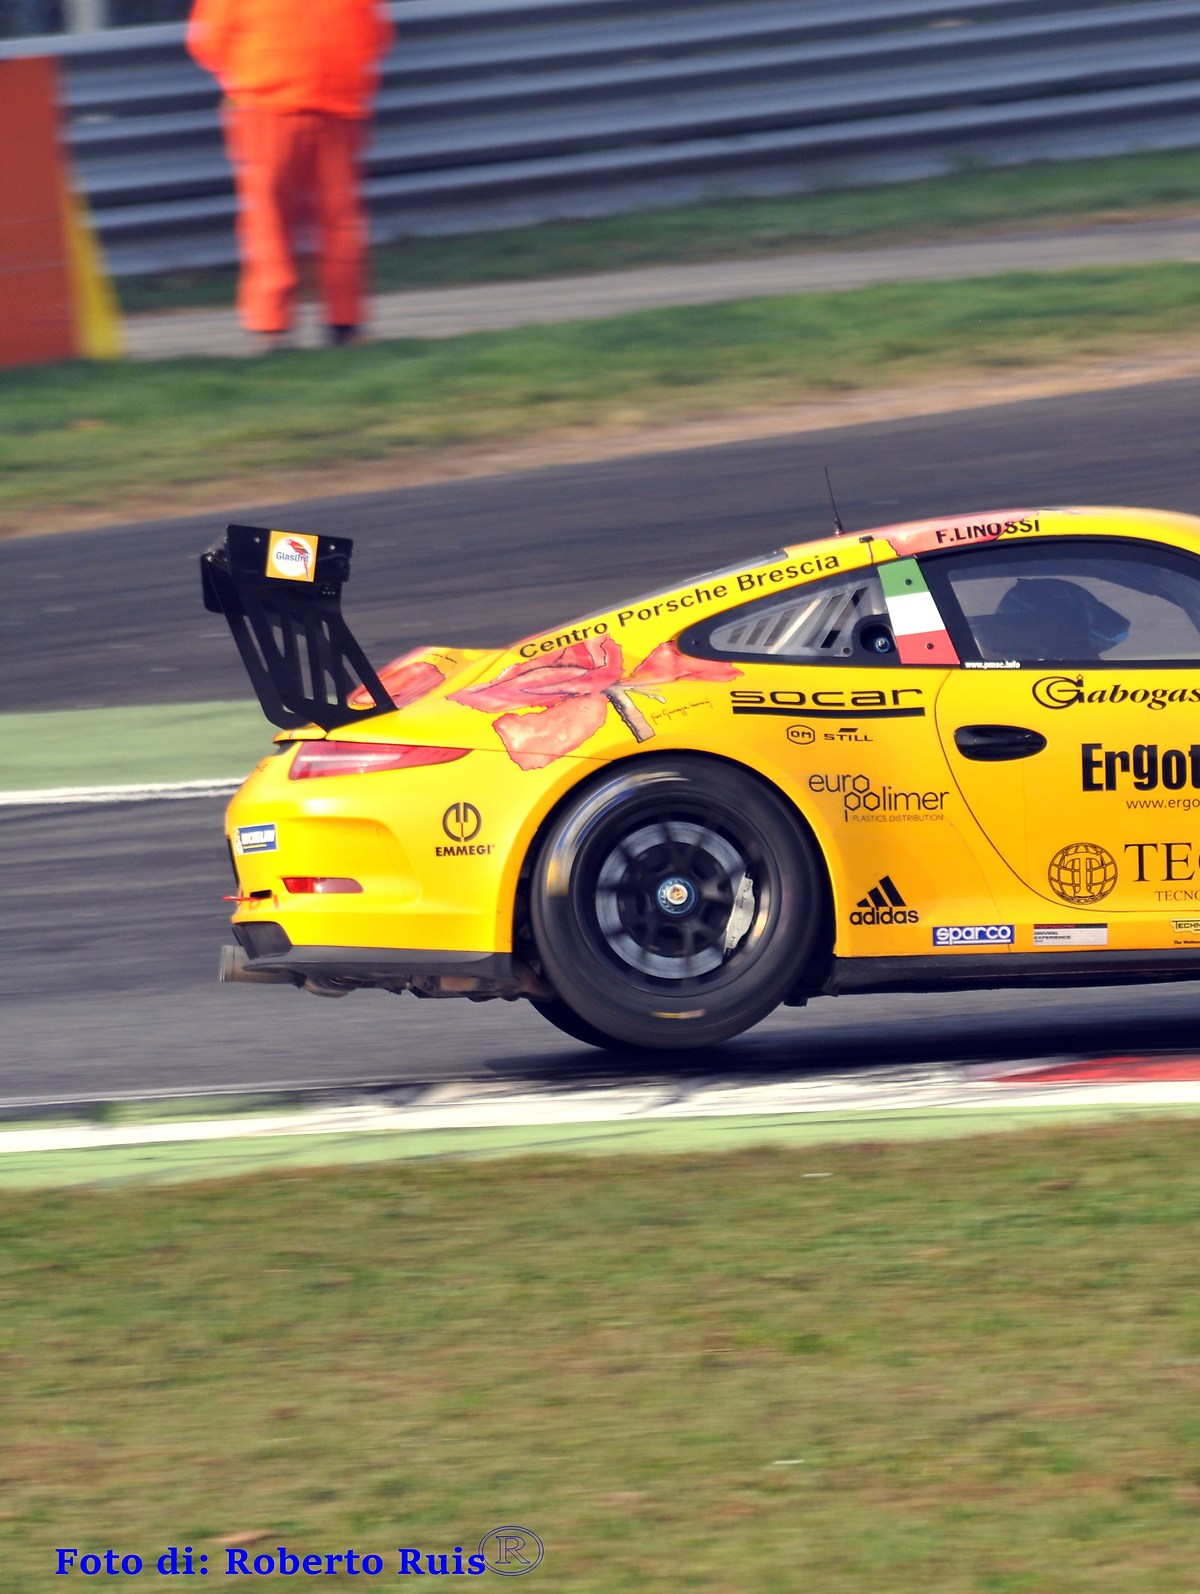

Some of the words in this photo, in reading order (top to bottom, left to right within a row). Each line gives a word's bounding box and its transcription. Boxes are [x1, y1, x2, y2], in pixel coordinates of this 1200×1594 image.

[936, 520, 1040, 544] F.LINOSSI
[519, 622, 608, 659] Centro
[617, 586, 728, 627] Porsche
[737, 554, 840, 592] Brescia
[730, 688, 923, 707] socar
[791, 730, 812, 739] OM
[824, 733, 873, 742] STILL
[808, 774, 870, 794] euro
[844, 786, 950, 822] polimer
[853, 815, 887, 823] PLASTICS
[889, 814, 944, 822] DISTRIBUTION
[435, 844, 491, 857] EMMEGI
[849, 906, 920, 926] adidas
[936, 924, 1011, 944] sparco
